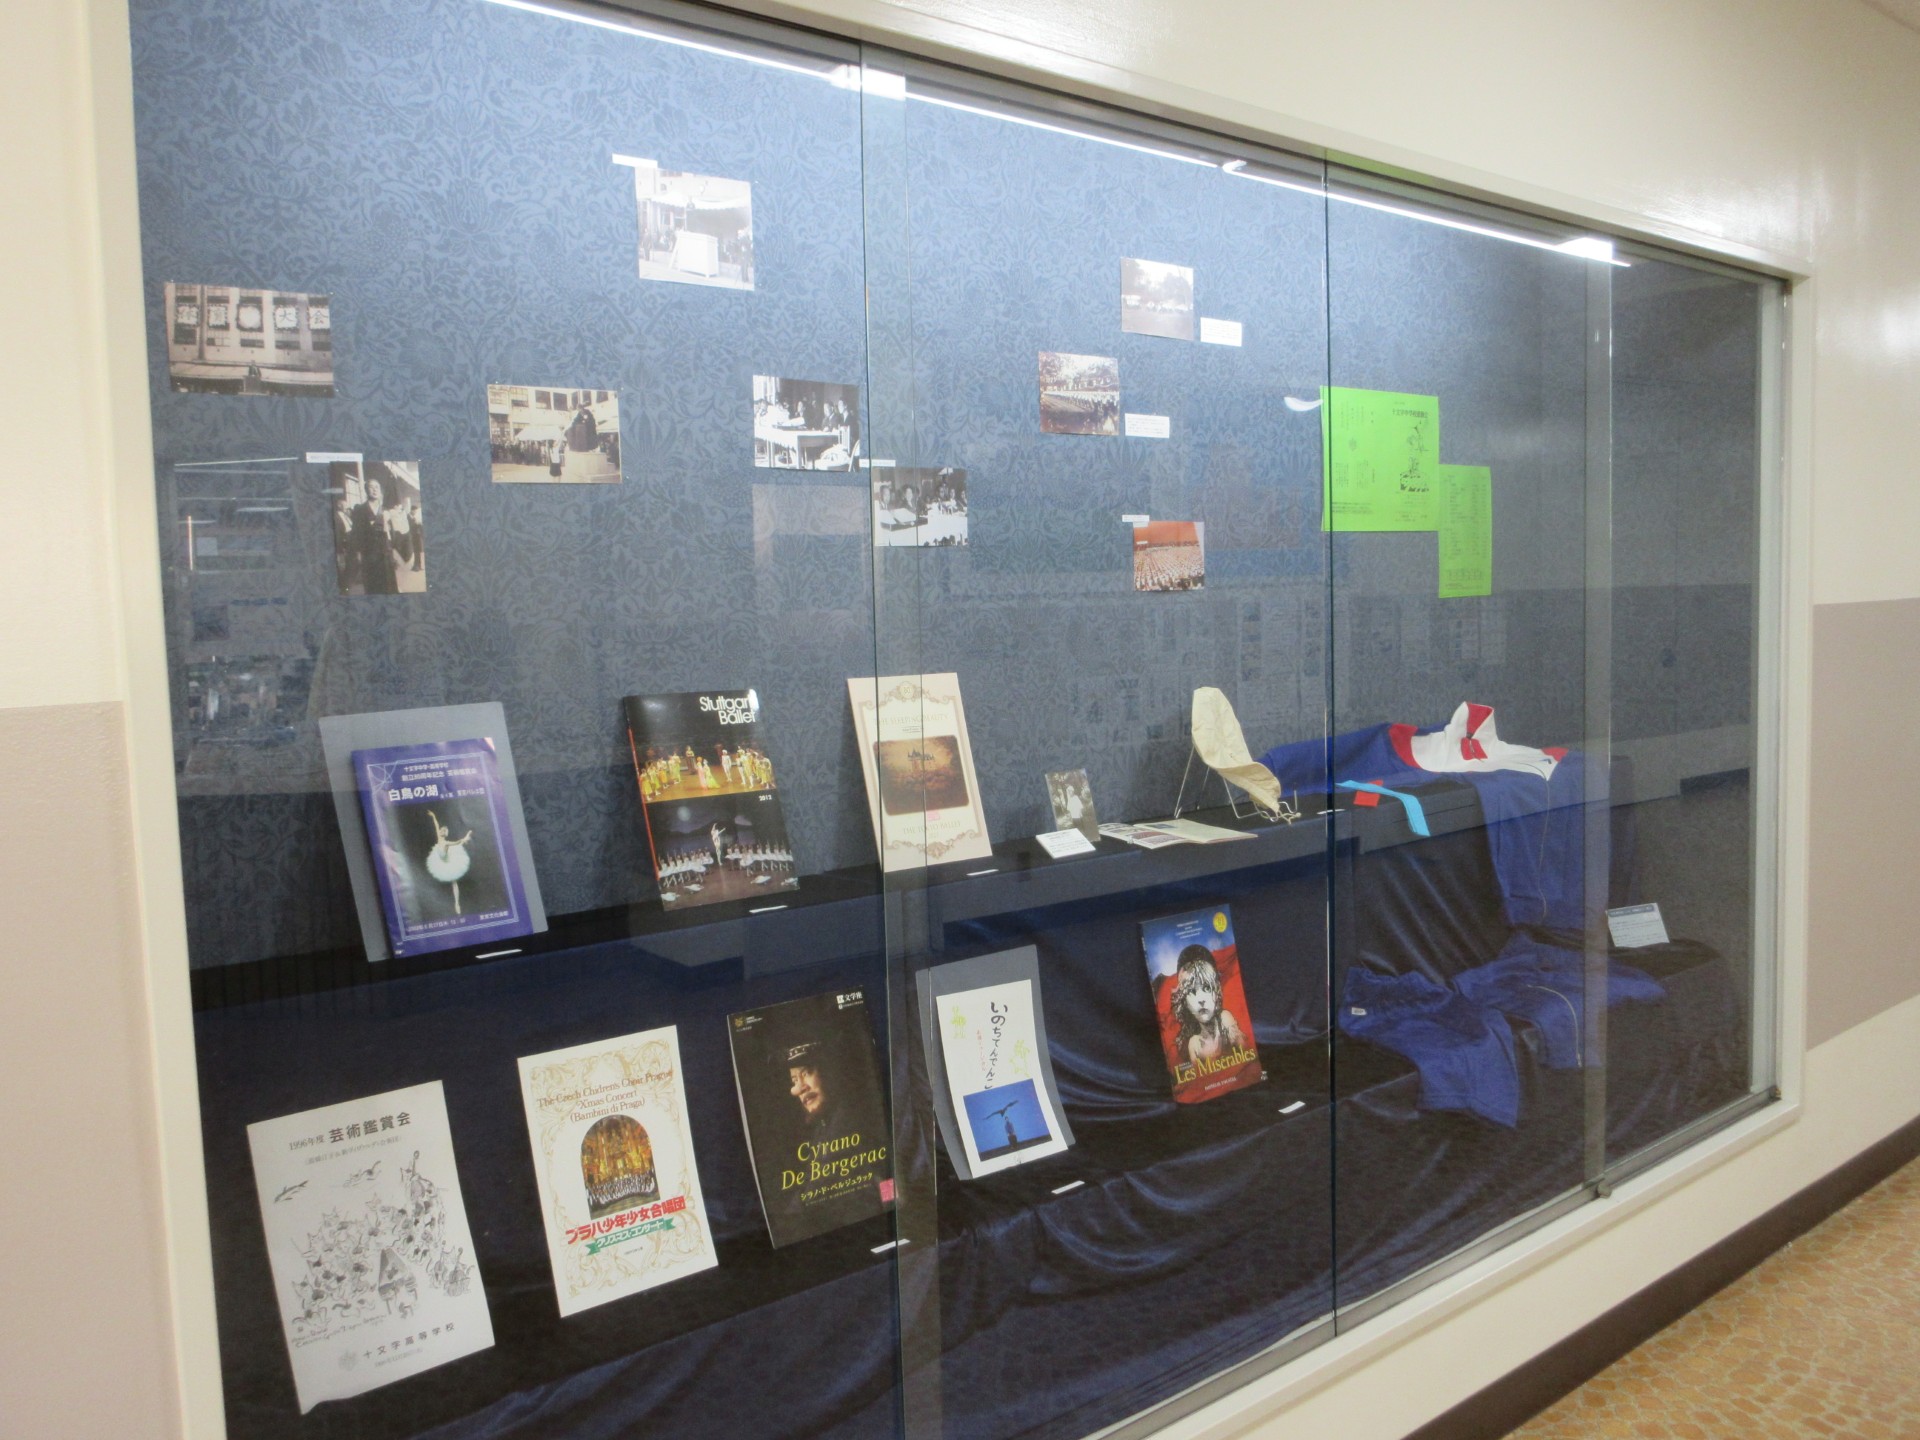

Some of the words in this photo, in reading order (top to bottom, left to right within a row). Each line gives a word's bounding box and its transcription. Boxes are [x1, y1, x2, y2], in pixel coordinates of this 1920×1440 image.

[718, 709, 756, 725] Ballet
[388, 784, 439, 801] 白鳥の湖
[1174, 1065, 1196, 1084] Les
[1196, 1044, 1256, 1076] Misérables
[605, 1090, 637, 1103] Concert
[328, 1112, 411, 1143] 芸術鑑賞会
[797, 1133, 860, 1162] Cyrano
[781, 1170, 805, 1190] De
[810, 1147, 887, 1181] Bergerac
